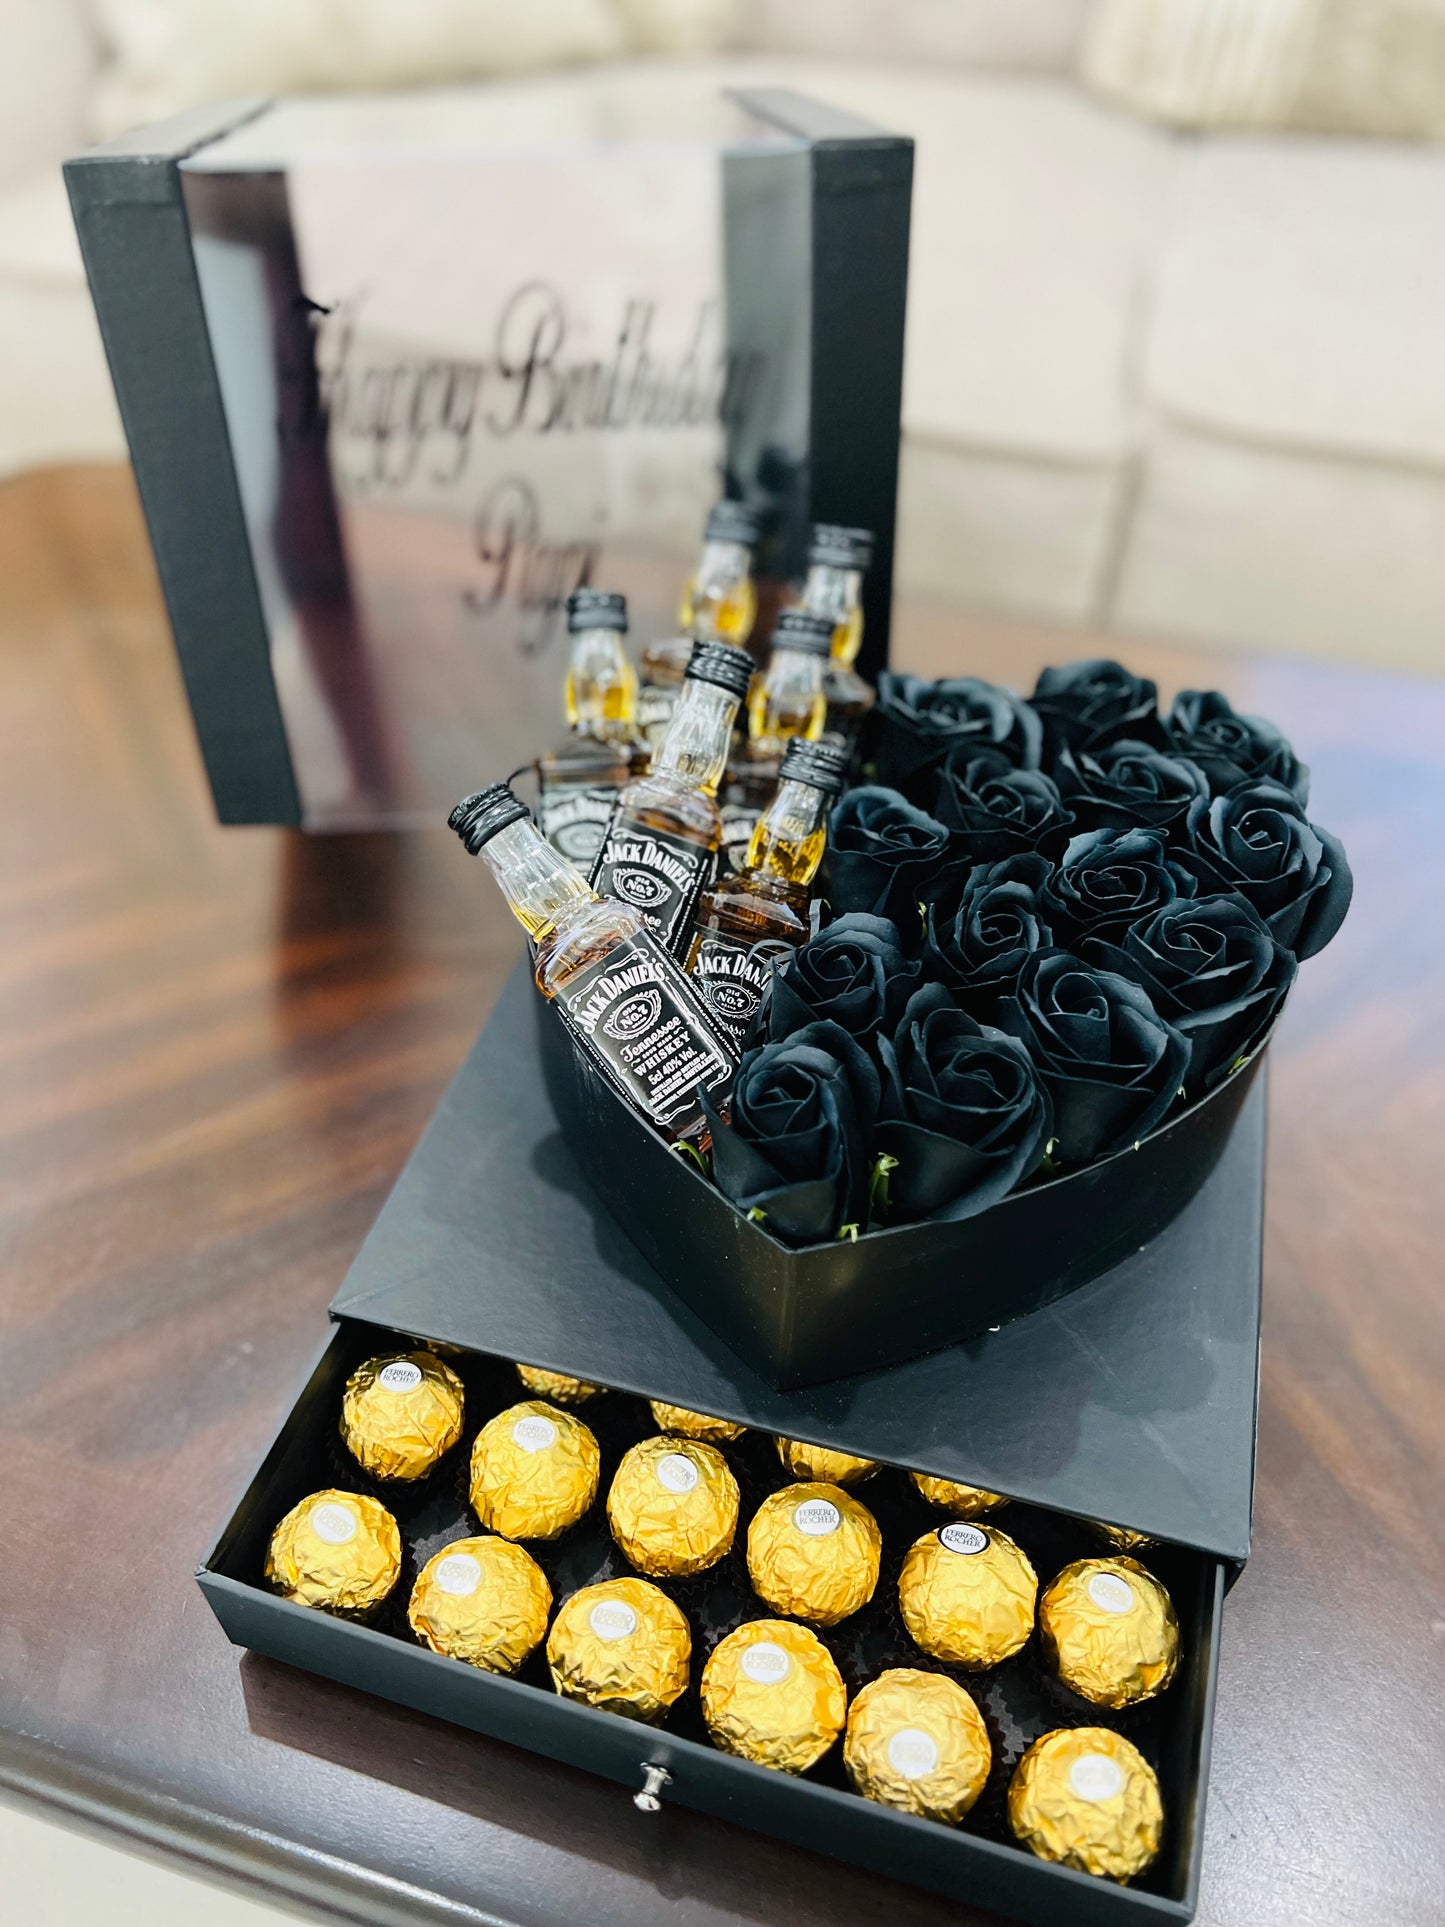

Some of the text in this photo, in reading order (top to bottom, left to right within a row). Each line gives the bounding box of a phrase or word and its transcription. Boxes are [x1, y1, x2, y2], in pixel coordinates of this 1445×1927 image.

[603, 840, 642, 864] JACK
[641, 841, 696, 893] DANIEL'S
[693, 953, 732, 976] JACK
[574, 990, 611, 1034] JACK
[597, 957, 666, 1000] DANIEL'S
[620, 1016, 681, 1062] Tennessee
[633, 1030, 690, 1077] WHISKEY
[647, 1069, 664, 1085] 5cl
[662, 1056, 682, 1075] 40%
[679, 1046, 698, 1062] Vol.
[383, 1374, 416, 1384] ROCHER
[385, 1368, 419, 1379] FERRERO
[799, 1508, 836, 1517] FERRERO
[799, 1516, 837, 1525] ROCHER
[944, 1535, 981, 1548] ROCHER
[945, 1528, 983, 1542] FERRERO
